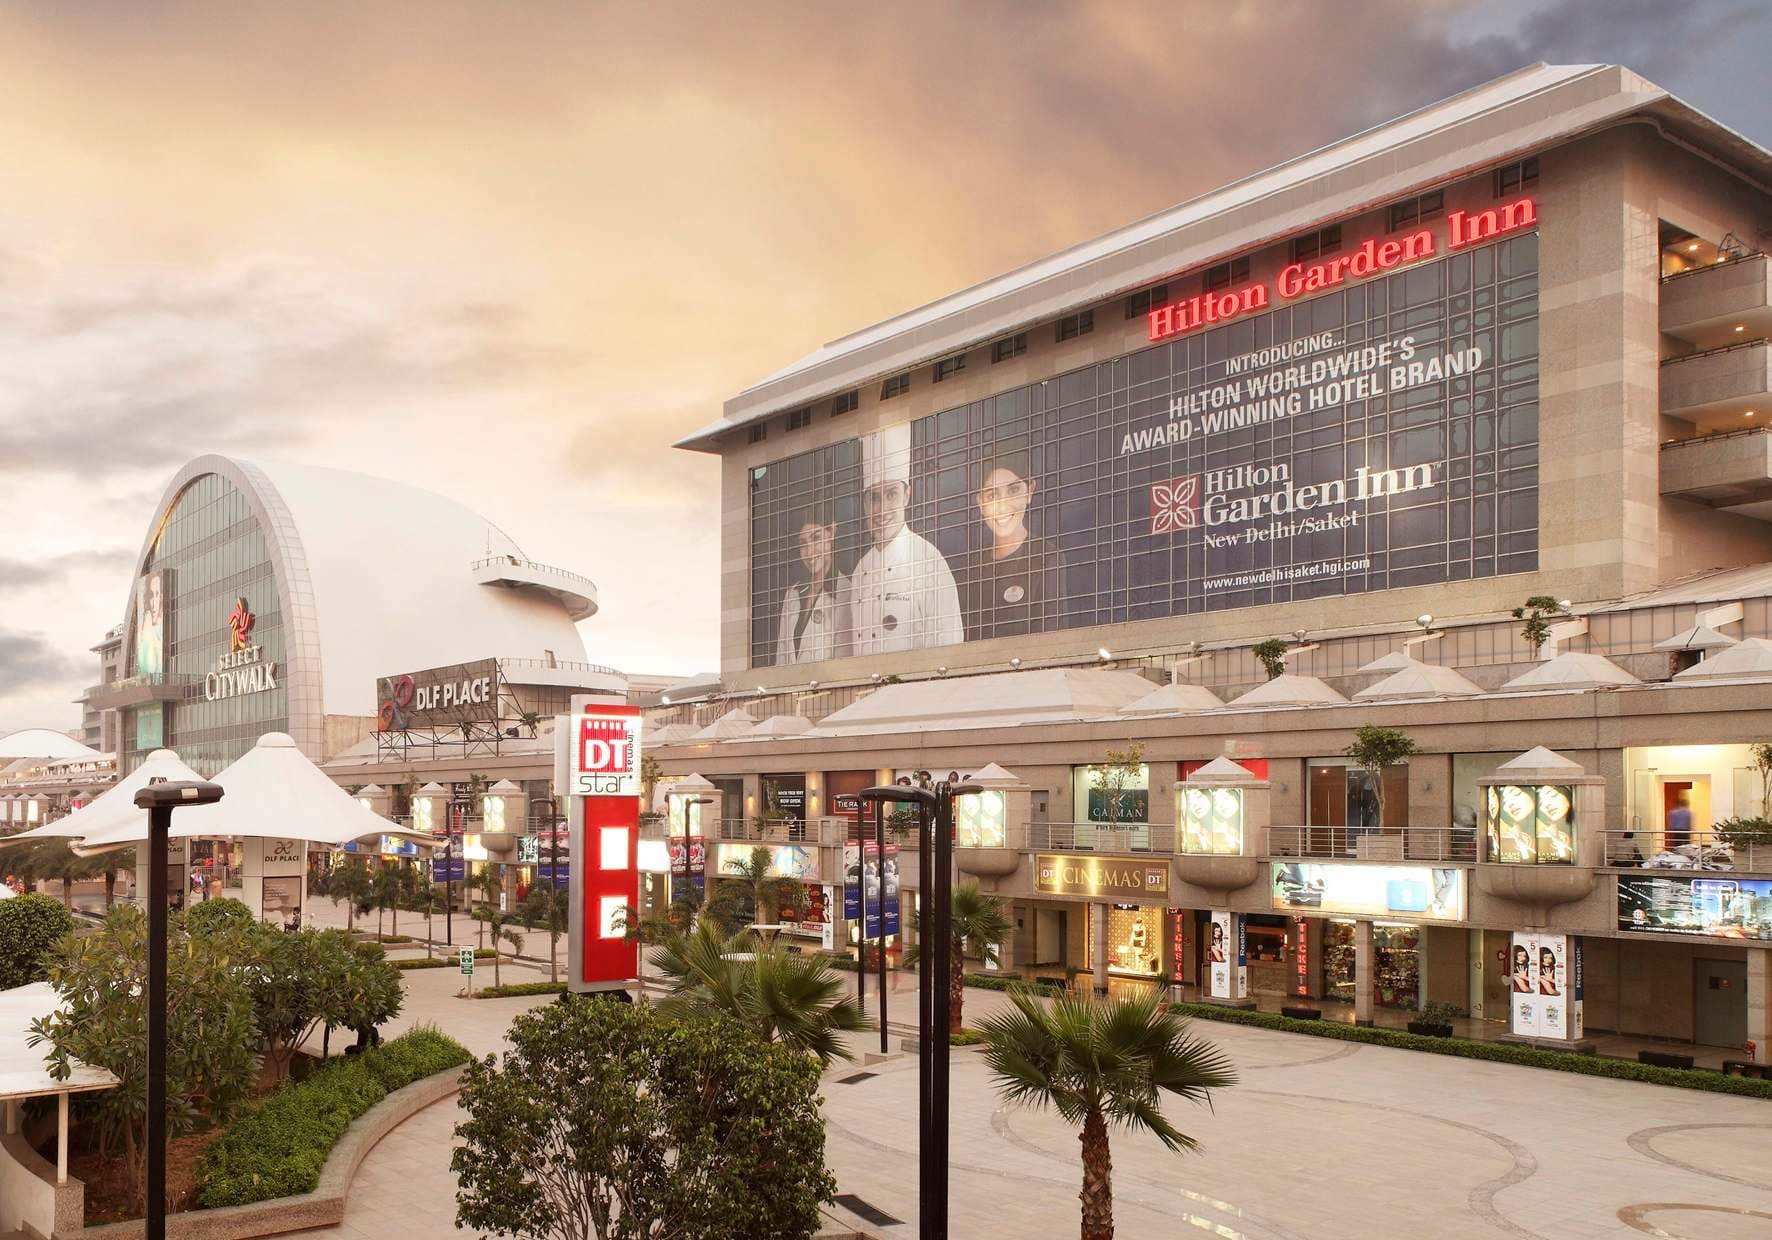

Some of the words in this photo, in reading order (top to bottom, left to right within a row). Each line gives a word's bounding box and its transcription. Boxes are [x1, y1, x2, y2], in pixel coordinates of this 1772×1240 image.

[1148, 281, 1268, 341] Hilton
[1277, 229, 1435, 299] Garden
[1448, 198, 1537, 249] Inn
[1121, 392, 1303, 454] AWARD-WINNING
[1309, 374, 1384, 410] HOTEL
[1390, 346, 1482, 390] BRAND
[1169, 378, 1242, 420] HILTON
[1205, 463, 1289, 495] Hilton
[1203, 479, 1345, 526] Garden
[1203, 533, 1240, 550] New
[1245, 510, 1359, 544] Delhi/Saket
[1203, 558, 1370, 590] www.newdelhisaket.hgi.com
[219, 646, 260, 668] SELECT
[205, 662, 277, 701] CITYWALK
[416, 684, 440, 711] DLF
[444, 677, 490, 706] PLACE
[585, 740, 627, 769] DT
[579, 772, 627, 793] star
[1063, 867, 1141, 888] CINEMAS
[1148, 875, 1161, 884] DT
[1297, 923, 1307, 995] TICKETS
[1530, 942, 1536, 950] 5
[1556, 945, 1562, 953] 5
